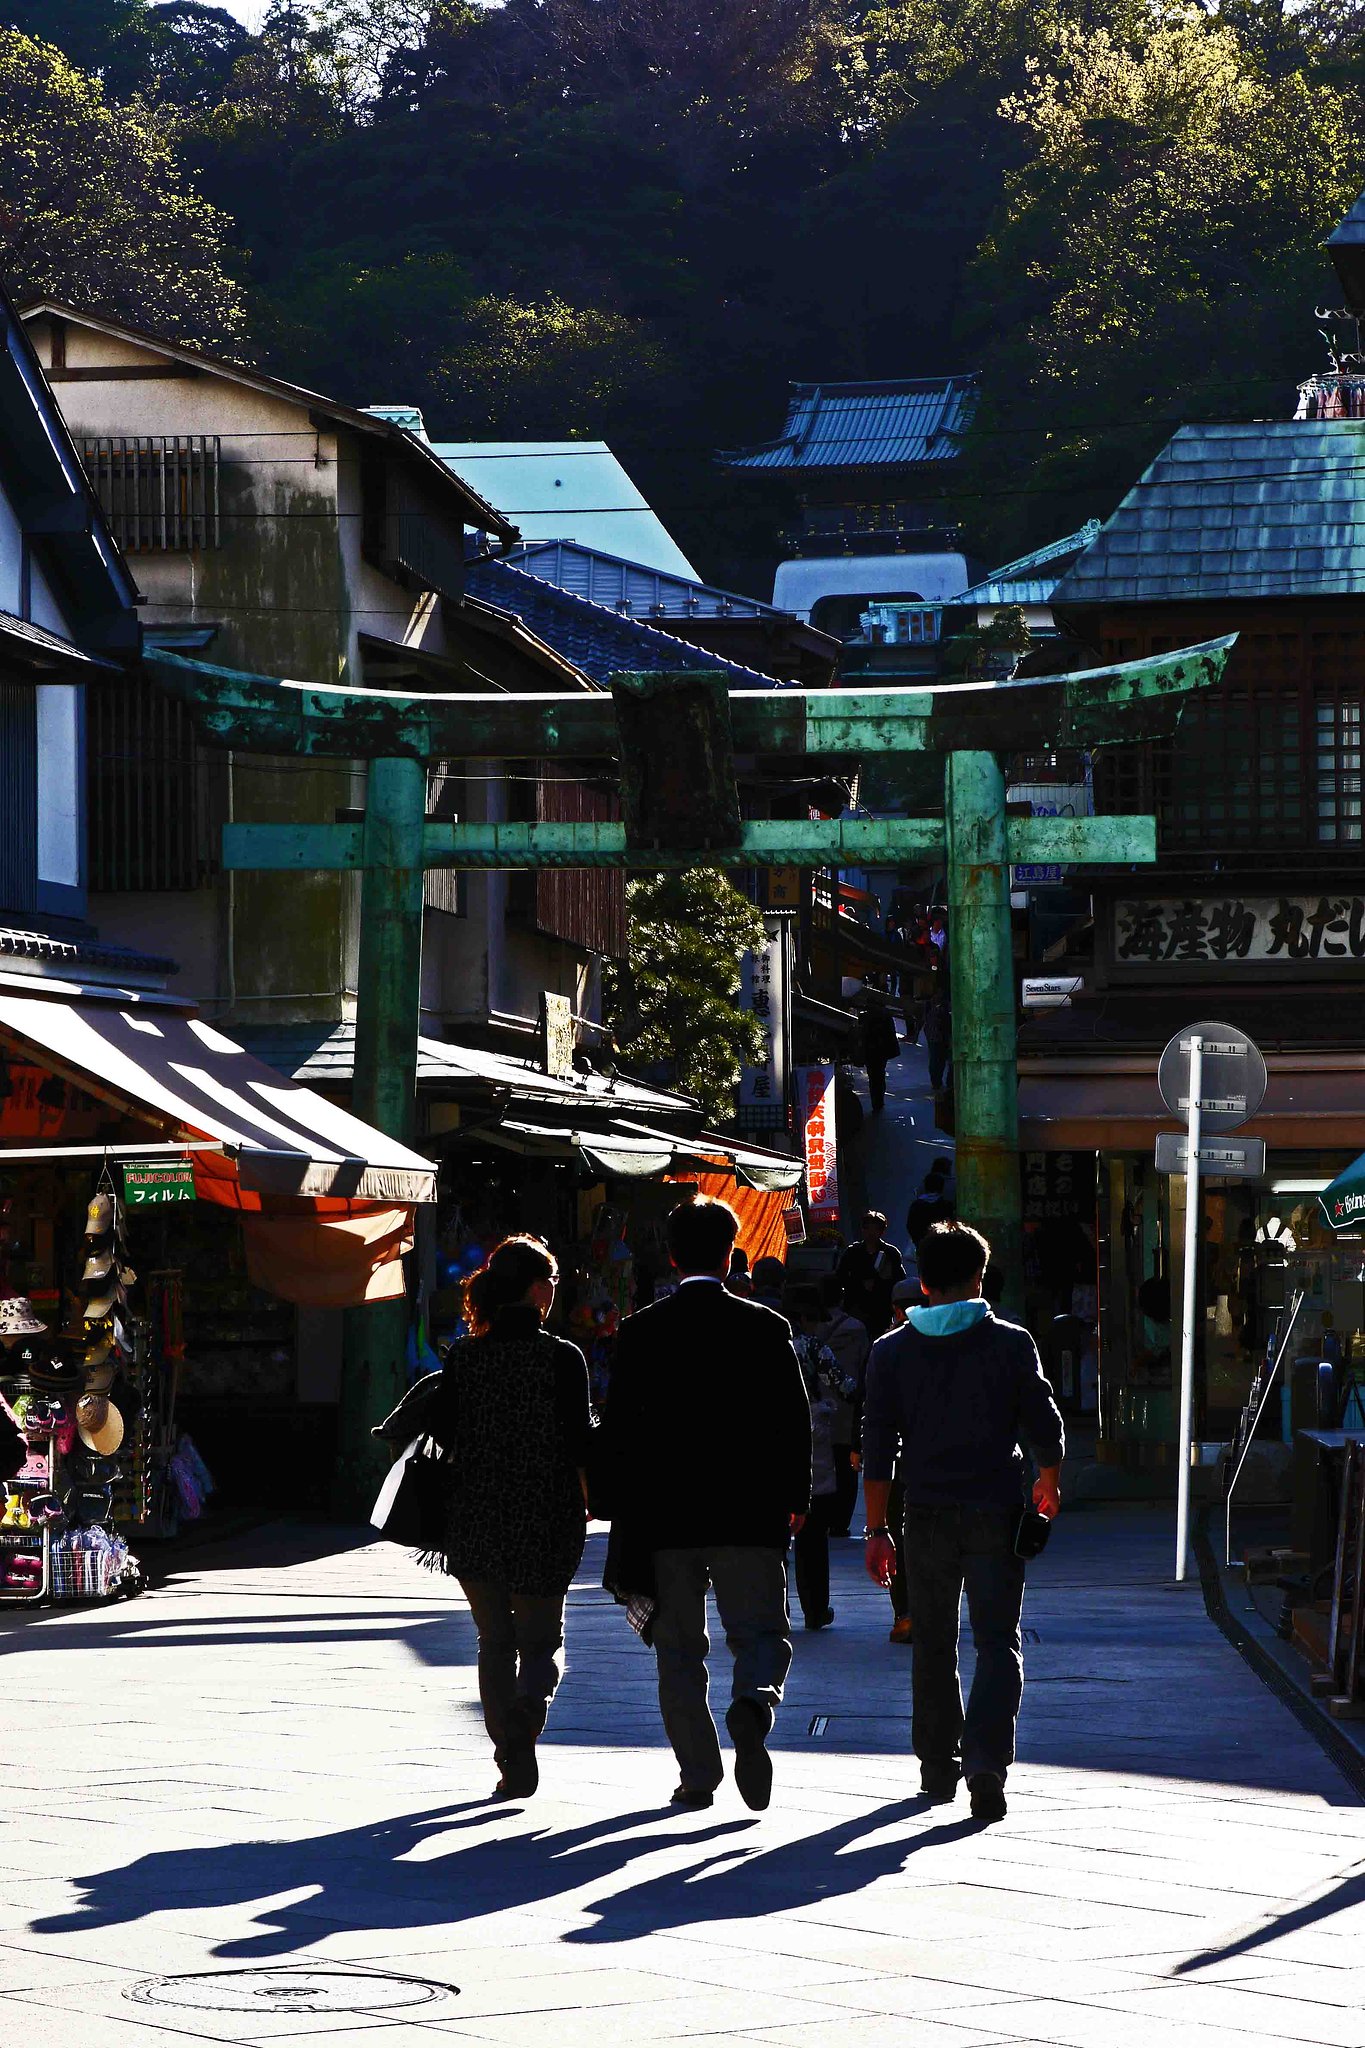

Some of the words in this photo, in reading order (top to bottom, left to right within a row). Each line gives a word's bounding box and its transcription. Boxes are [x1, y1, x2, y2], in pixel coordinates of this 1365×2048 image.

[1118, 900, 1256, 960] 海産物
[1026, 984, 1044, 992] Seven
[1044, 983, 1061, 992] Stars
[126, 1172, 192, 1184] FUJICOLOR
[133, 1189, 191, 1203] フィルム
